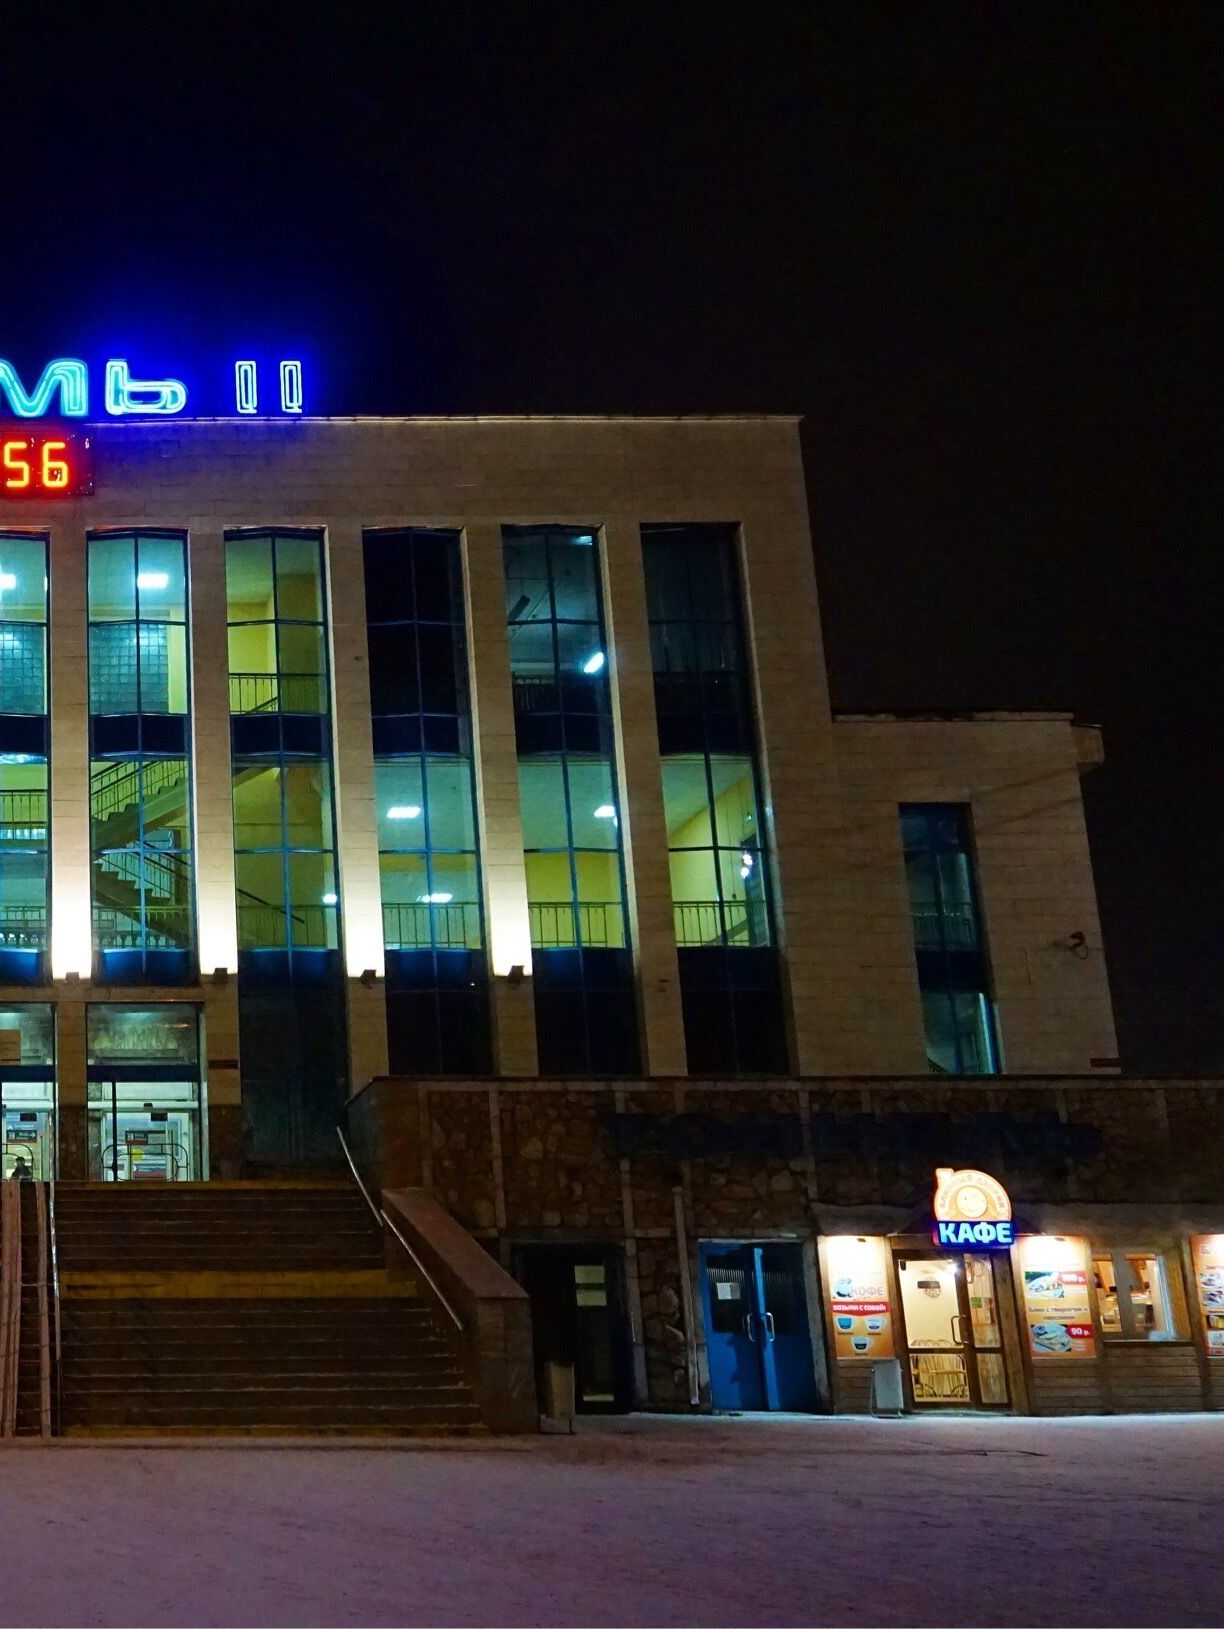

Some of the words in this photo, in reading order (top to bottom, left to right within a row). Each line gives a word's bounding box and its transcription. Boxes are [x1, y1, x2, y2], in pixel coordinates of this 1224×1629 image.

[233, 358, 306, 416] II
[938, 1221, 1013, 1244] КАФЕ
[850, 1285, 885, 1298] КОФЕ
[1070, 1327, 1083, 1336] 90
